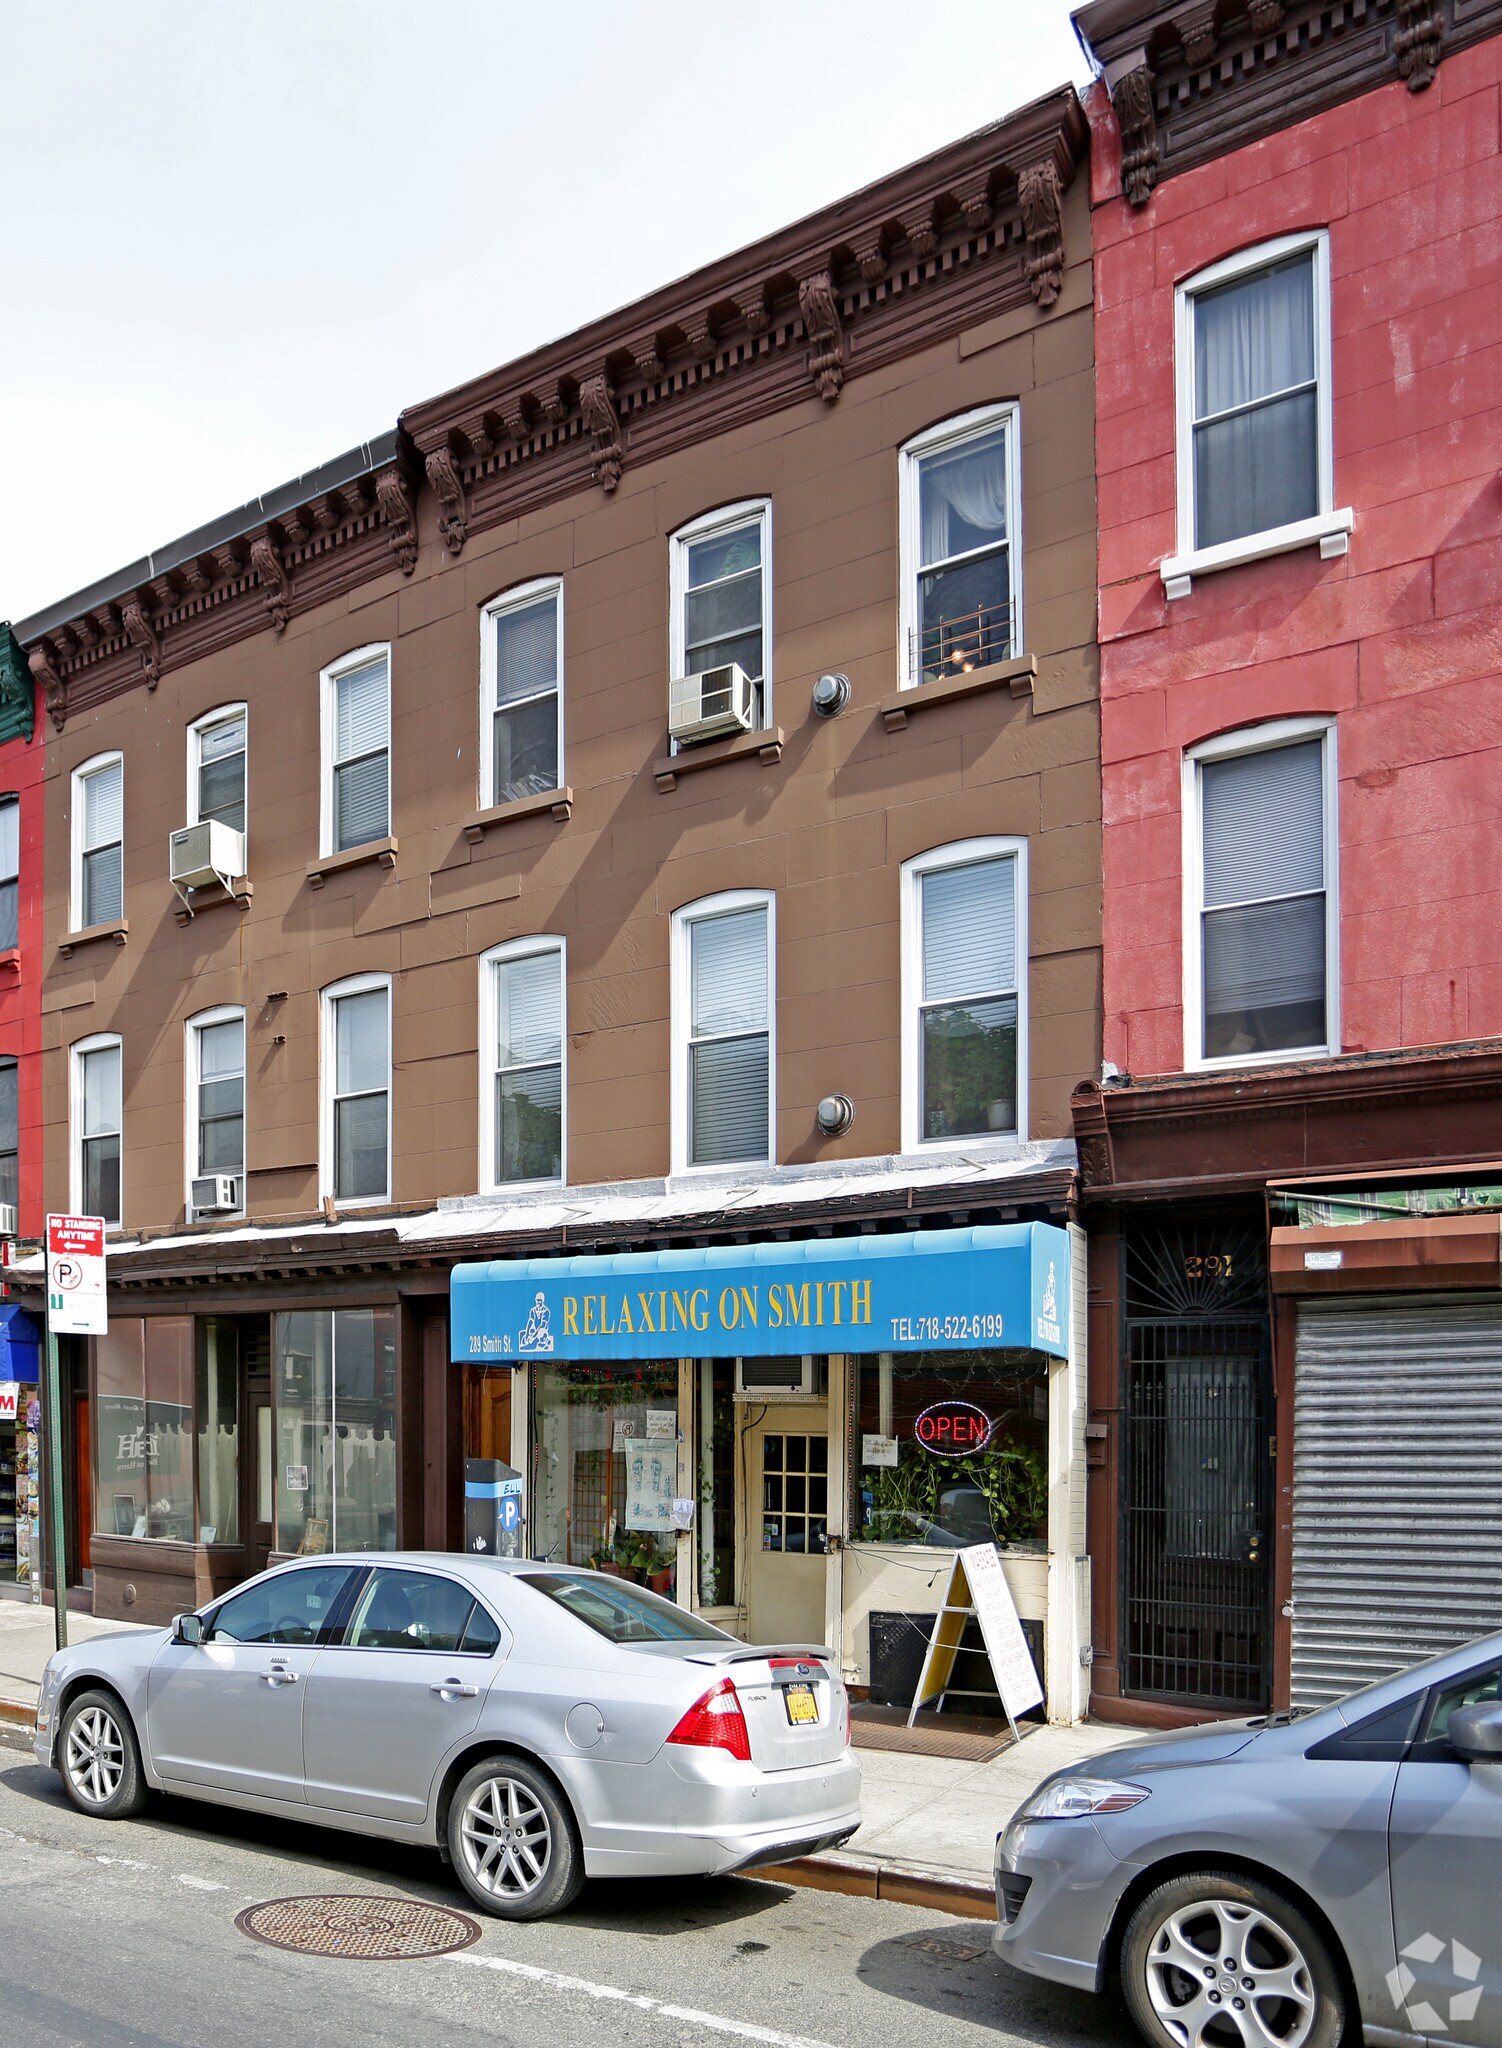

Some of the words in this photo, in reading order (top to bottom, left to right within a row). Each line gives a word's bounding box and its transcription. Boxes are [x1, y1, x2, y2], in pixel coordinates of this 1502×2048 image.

[51, 1219, 63, 1228] NO
[64, 1220, 101, 1230] STANDING
[57, 1230, 96, 1241] ANYTIME
[1184, 1255, 1233, 1277] 291
[562, 1289, 711, 1335] RELAXING
[718, 1285, 759, 1330] ON
[767, 1279, 873, 1328] SMITH
[890, 1314, 1004, 1342] TEL:718-522-6199
[469, 1335, 481, 1353] 289
[482, 1334, 502, 1353] Smith
[503, 1334, 513, 1353] St.
[919, 1416, 985, 1441] OPEN
[505, 1501, 516, 1527] P
